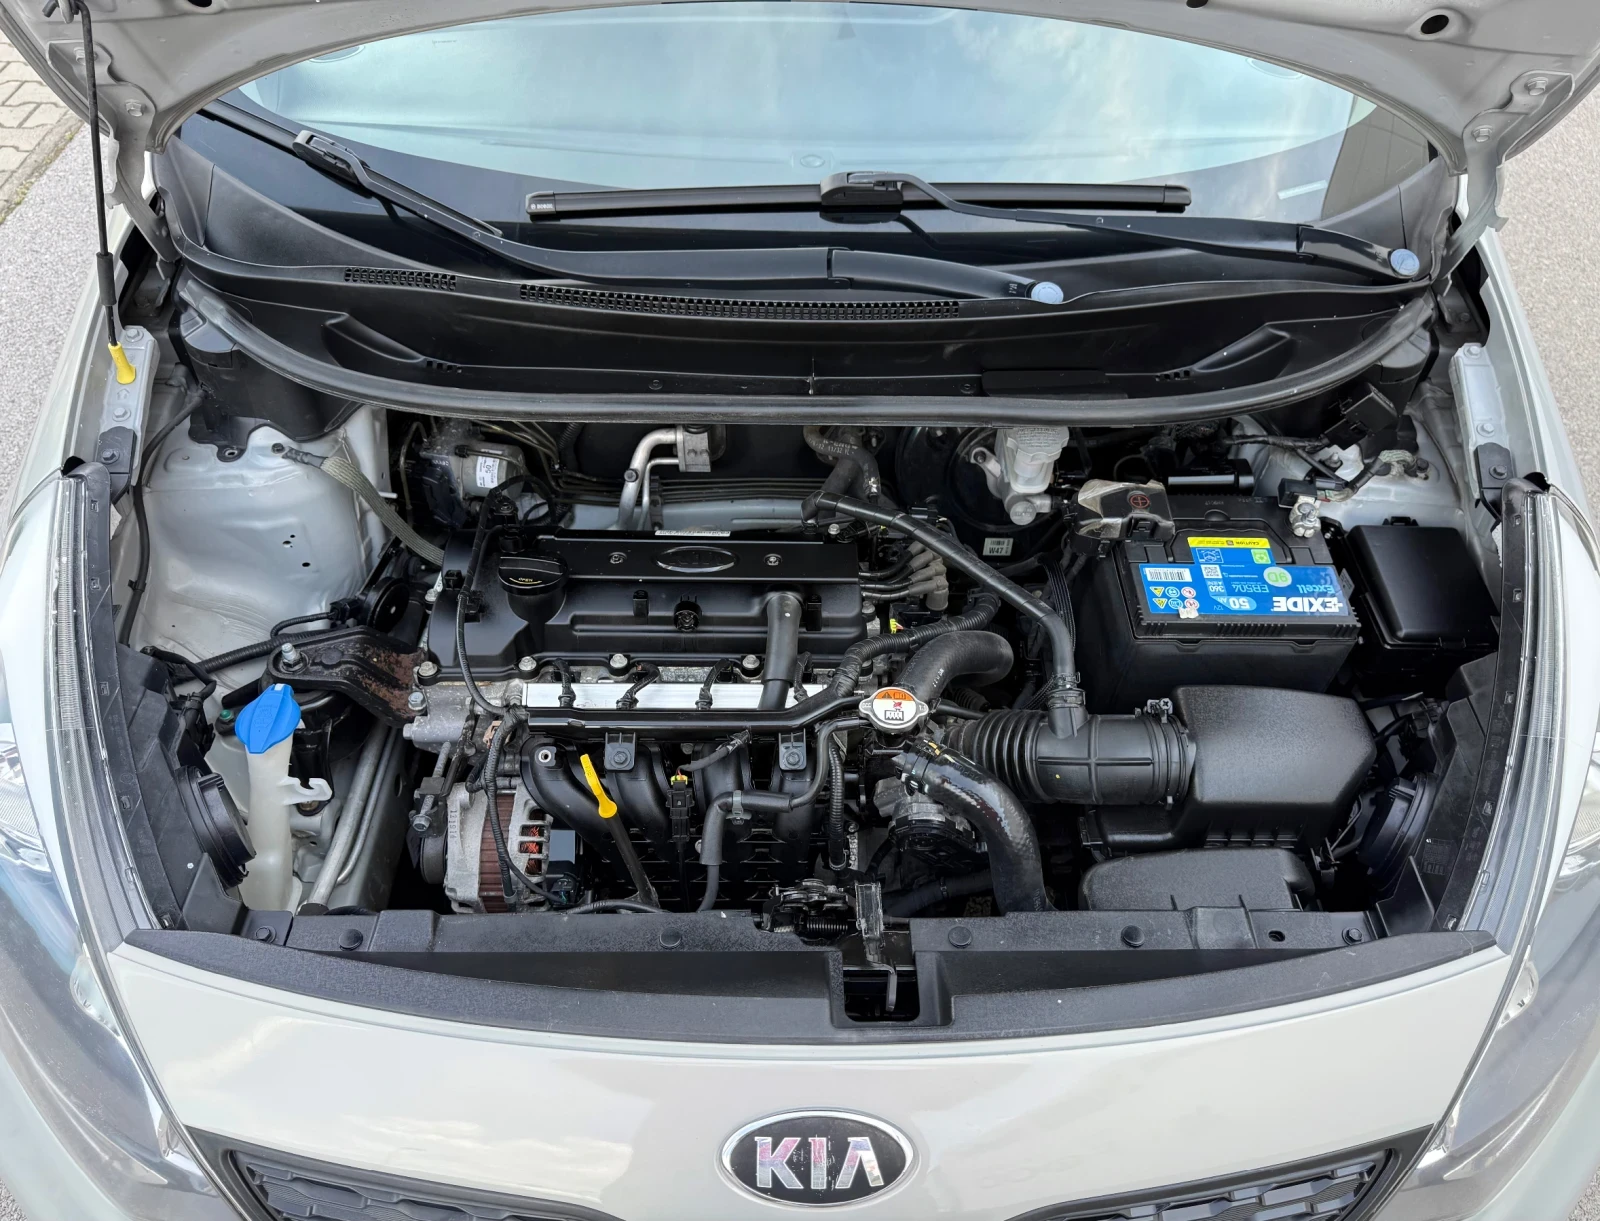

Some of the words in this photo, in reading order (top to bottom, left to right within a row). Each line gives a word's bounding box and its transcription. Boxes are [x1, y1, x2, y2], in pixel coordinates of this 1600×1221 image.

[1267, 571, 1289, 583] 9D
[1232, 584, 1270, 593] EB504
[1296, 584, 1335, 594] Excell
[1229, 597, 1250, 609] 50
[1271, 596, 1343, 612] EXIDE
[755, 1136, 884, 1189] KIA
